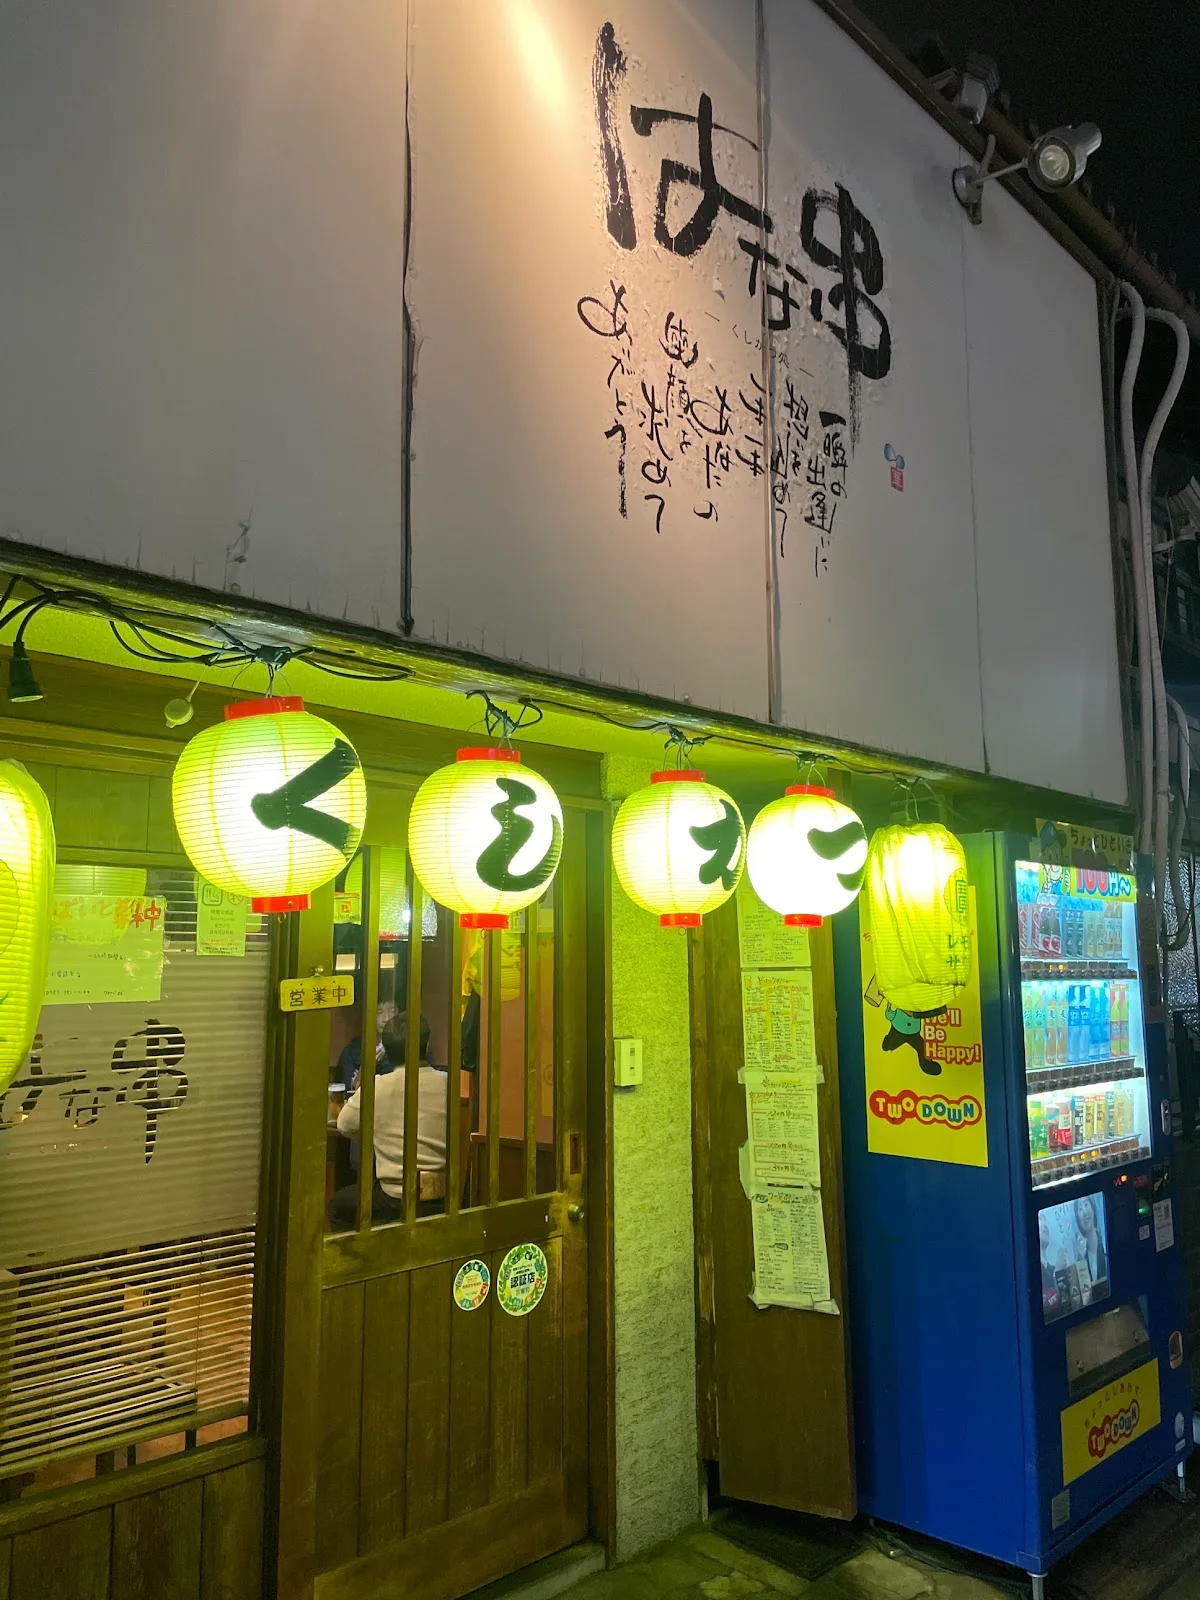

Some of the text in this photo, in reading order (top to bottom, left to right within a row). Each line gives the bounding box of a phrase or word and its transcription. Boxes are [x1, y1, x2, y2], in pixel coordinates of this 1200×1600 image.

[289, 984, 347, 1007] 営業中
[925, 1025, 945, 1041] Be
[925, 1042, 980, 1063] Happy!
[875, 1096, 975, 1124] TWO DOWN
